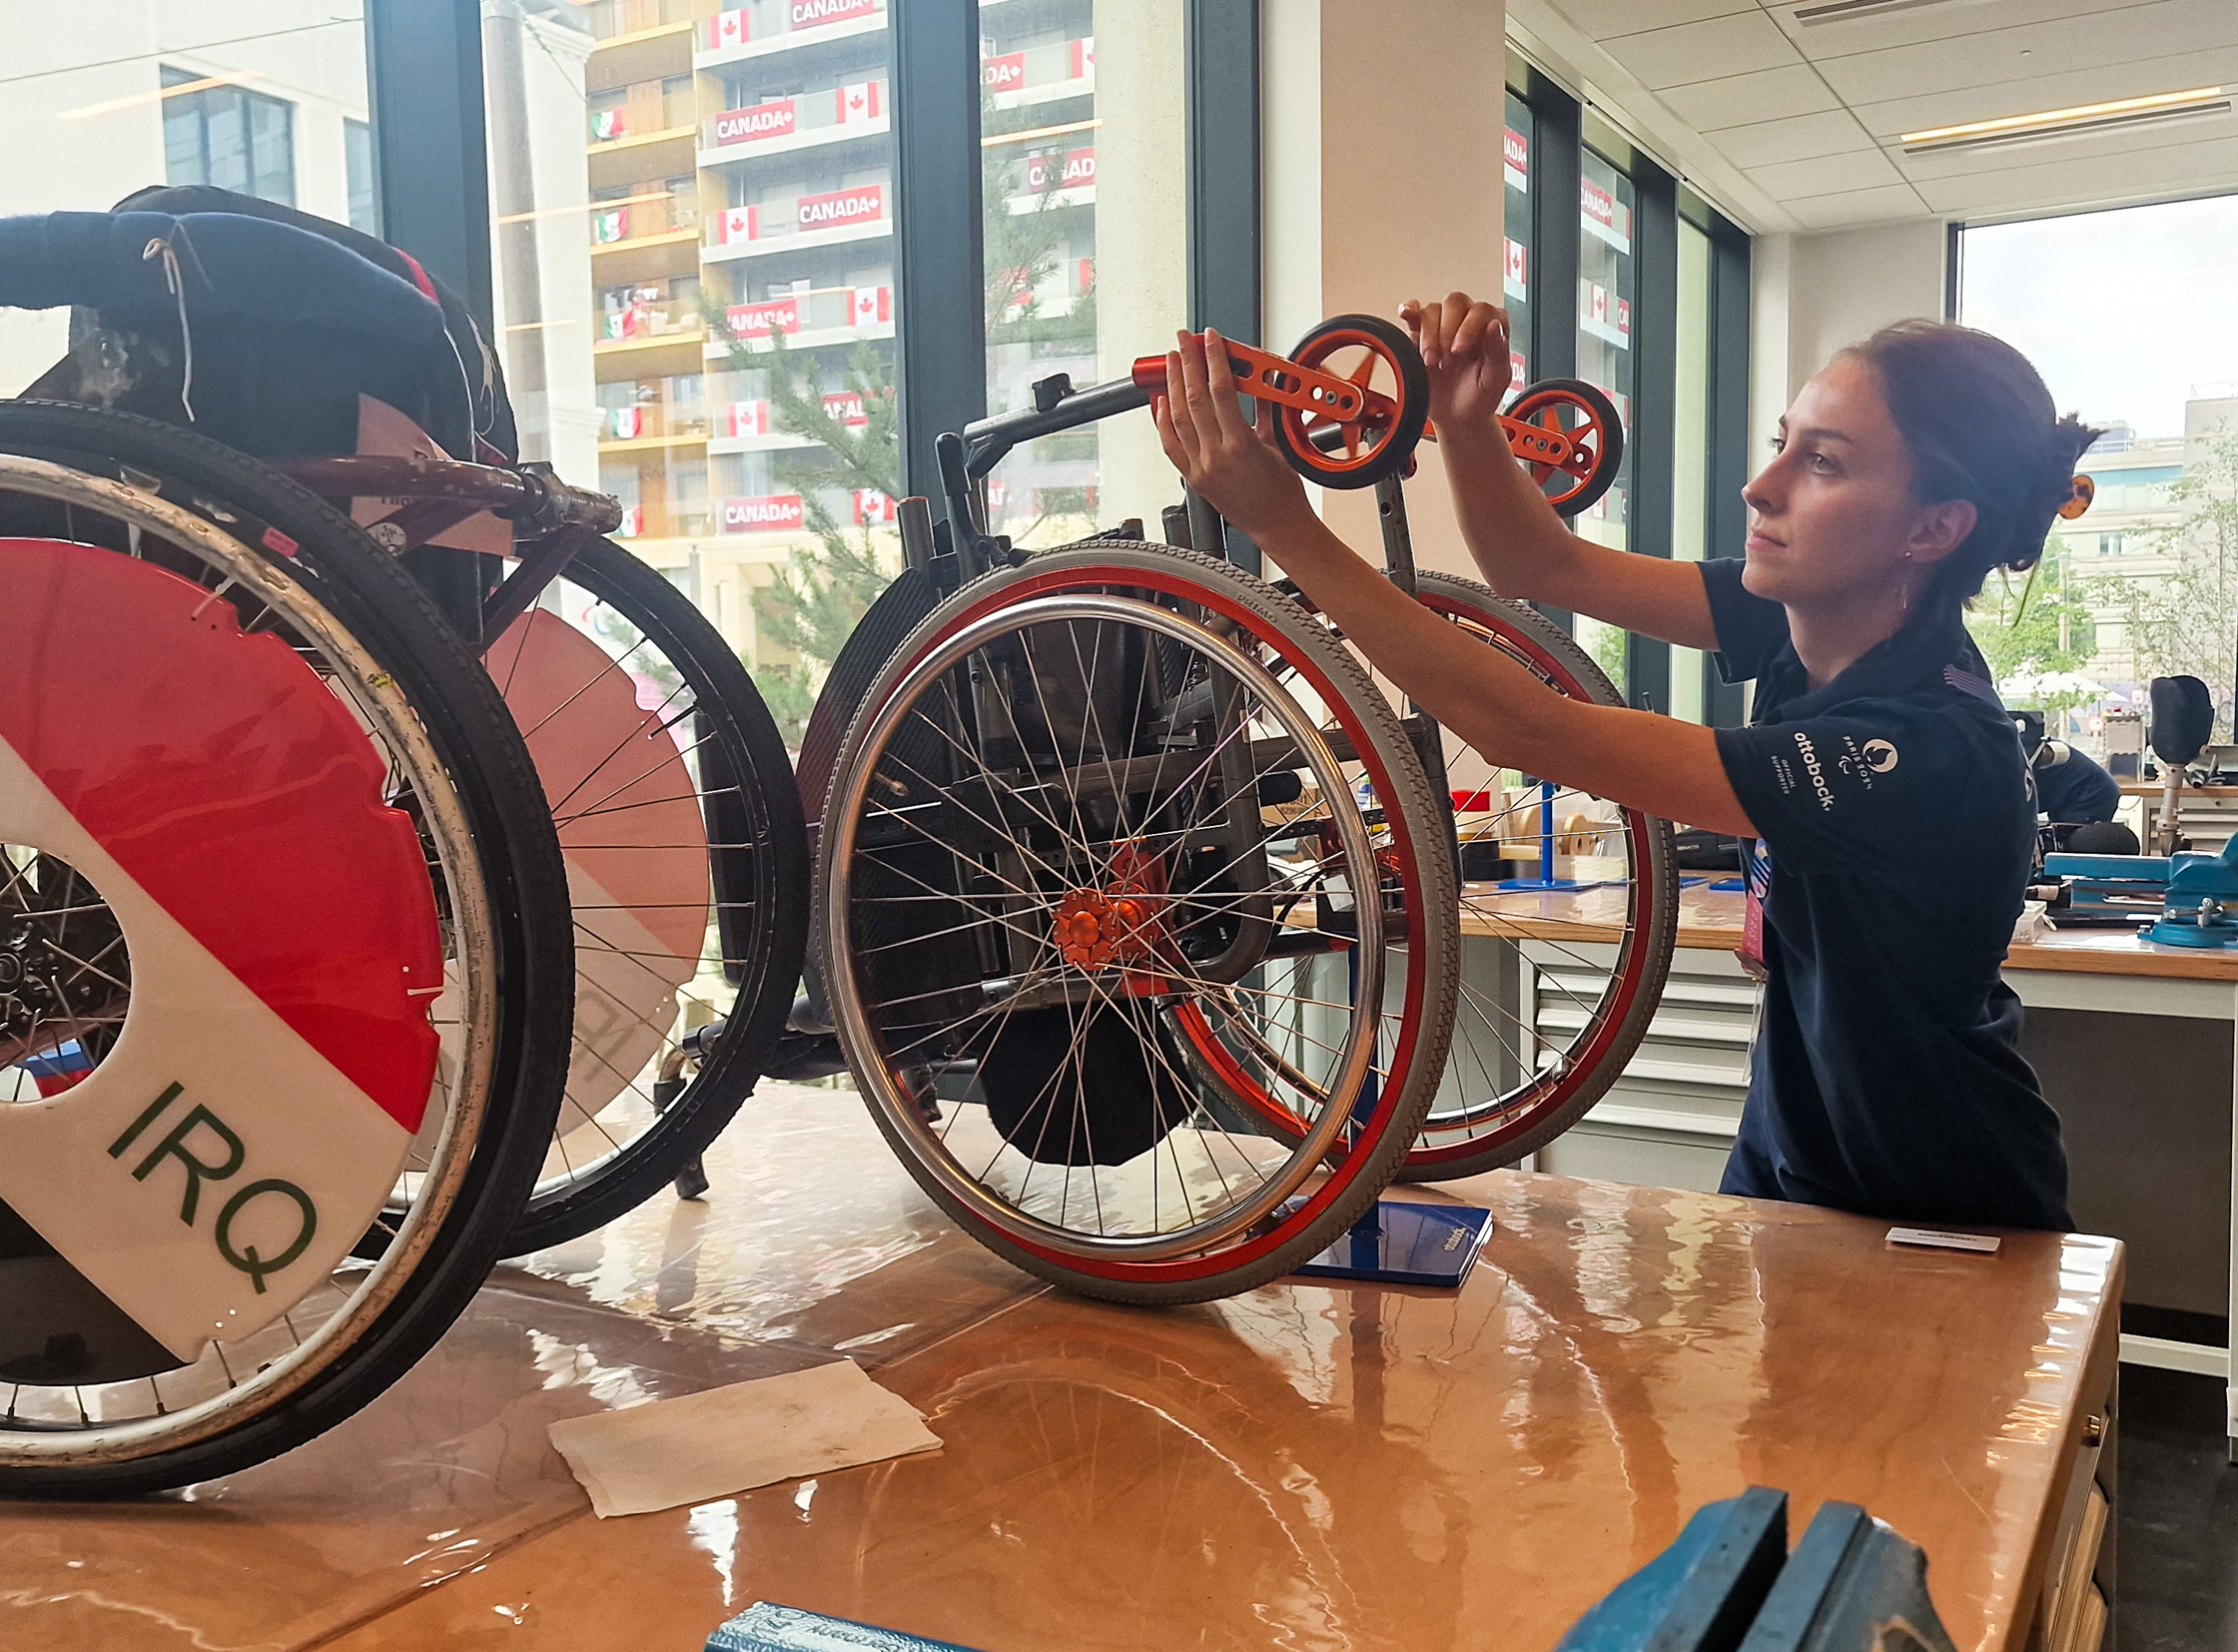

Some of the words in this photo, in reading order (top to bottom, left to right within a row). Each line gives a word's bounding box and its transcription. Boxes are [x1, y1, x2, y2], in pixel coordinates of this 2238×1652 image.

[717, 110, 786, 139] CANADA
[799, 196, 871, 224] CANADA
[725, 502, 794, 524] CANADA
[1781, 758, 1797, 789] OFFICIAL
[1843, 735, 1862, 762] PARIS
[1856, 764, 1872, 790] 2024
[107, 1080, 318, 1295] IRQ
